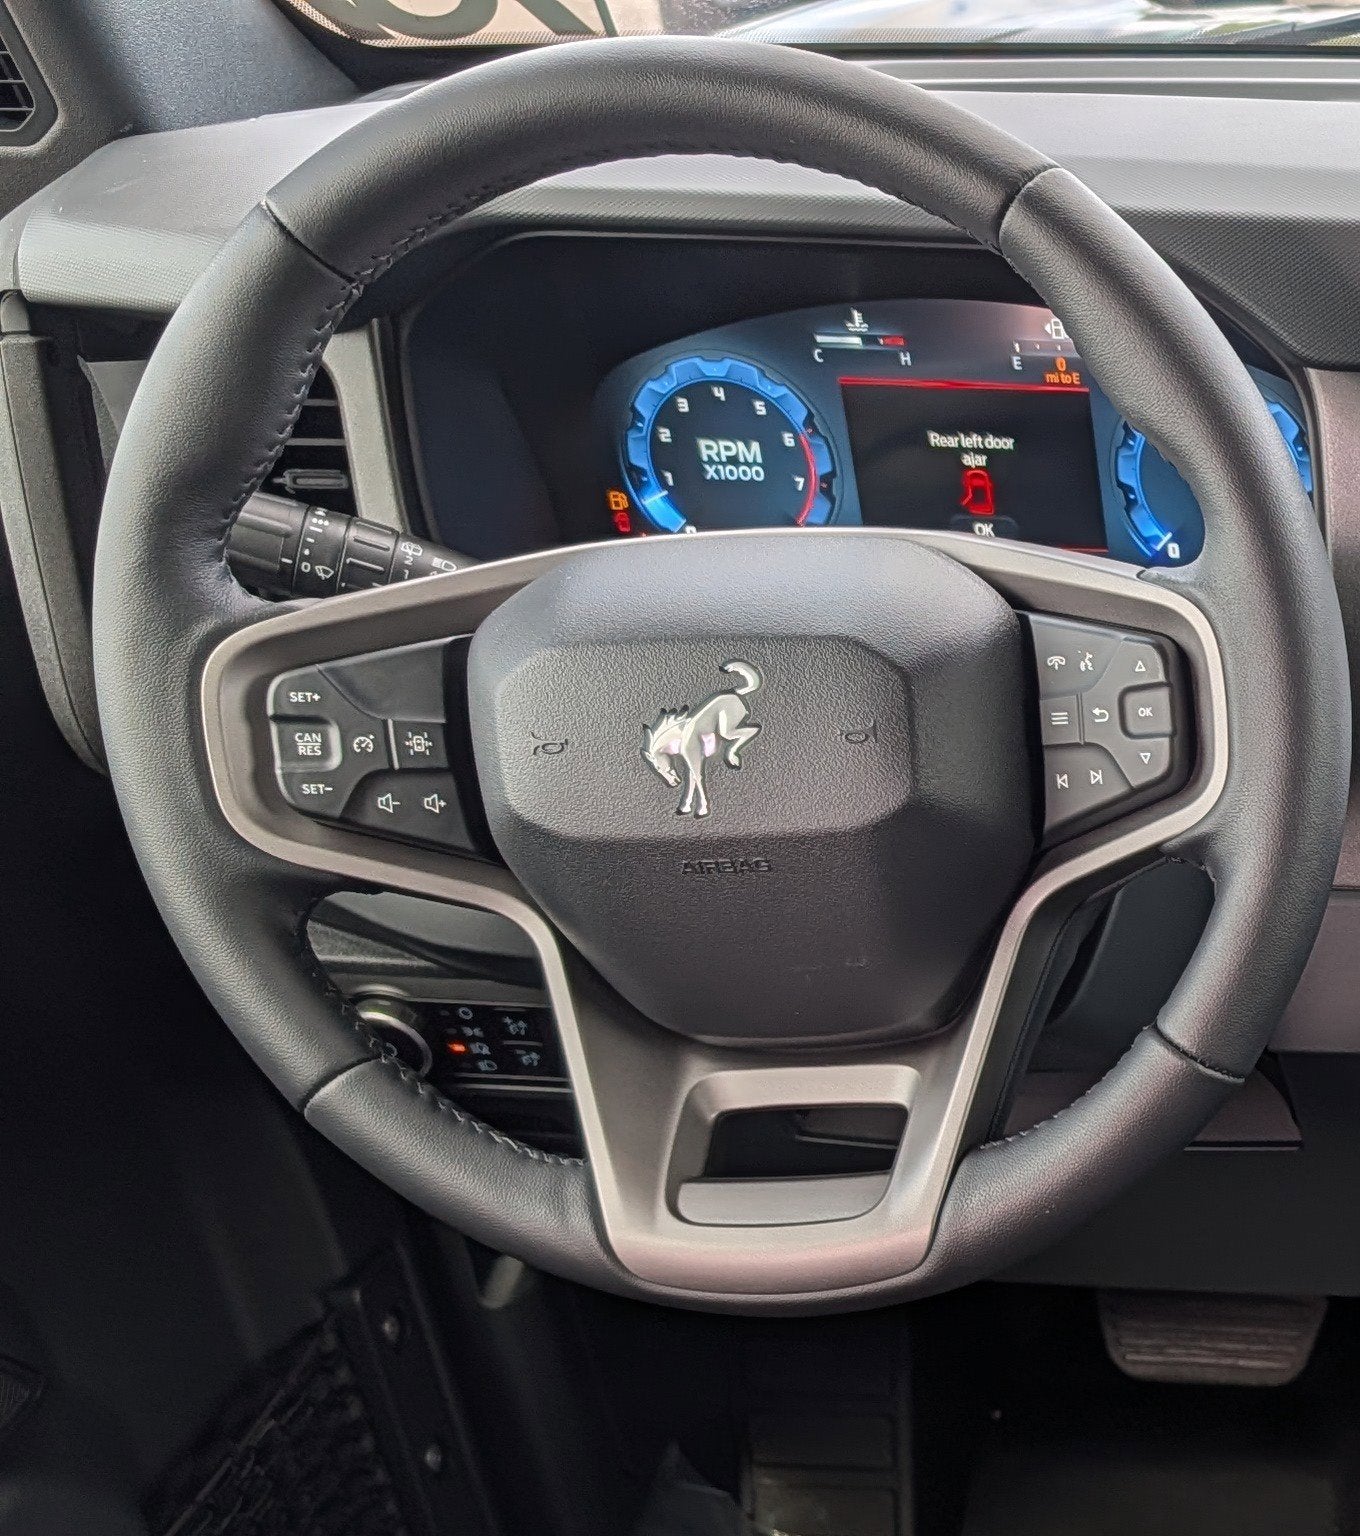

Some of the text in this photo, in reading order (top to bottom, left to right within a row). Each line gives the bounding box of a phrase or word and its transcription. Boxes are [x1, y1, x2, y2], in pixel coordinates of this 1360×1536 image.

[814, 350, 824, 363] C
[901, 351, 912, 366] H
[1013, 356, 1022, 370] E
[1044, 372, 1081, 385] mi to E
[712, 387, 726, 402] 4
[676, 397, 690, 413] 3
[753, 400, 767, 416] 5
[657, 426, 672, 443] 2
[782, 431, 796, 447] 6
[927, 430, 1015, 450] Rear left door
[697, 438, 763, 464] RPM
[961, 452, 988, 469] ajar
[702, 464, 765, 482] X1000
[793, 475, 805, 491] 7
[973, 521, 996, 538] OK
[289, 692, 321, 703] SET+
[1138, 707, 1153, 717] OK
[294, 732, 322, 742] CAN
[298, 746, 322, 756] RES
[302, 784, 334, 794] SET-
